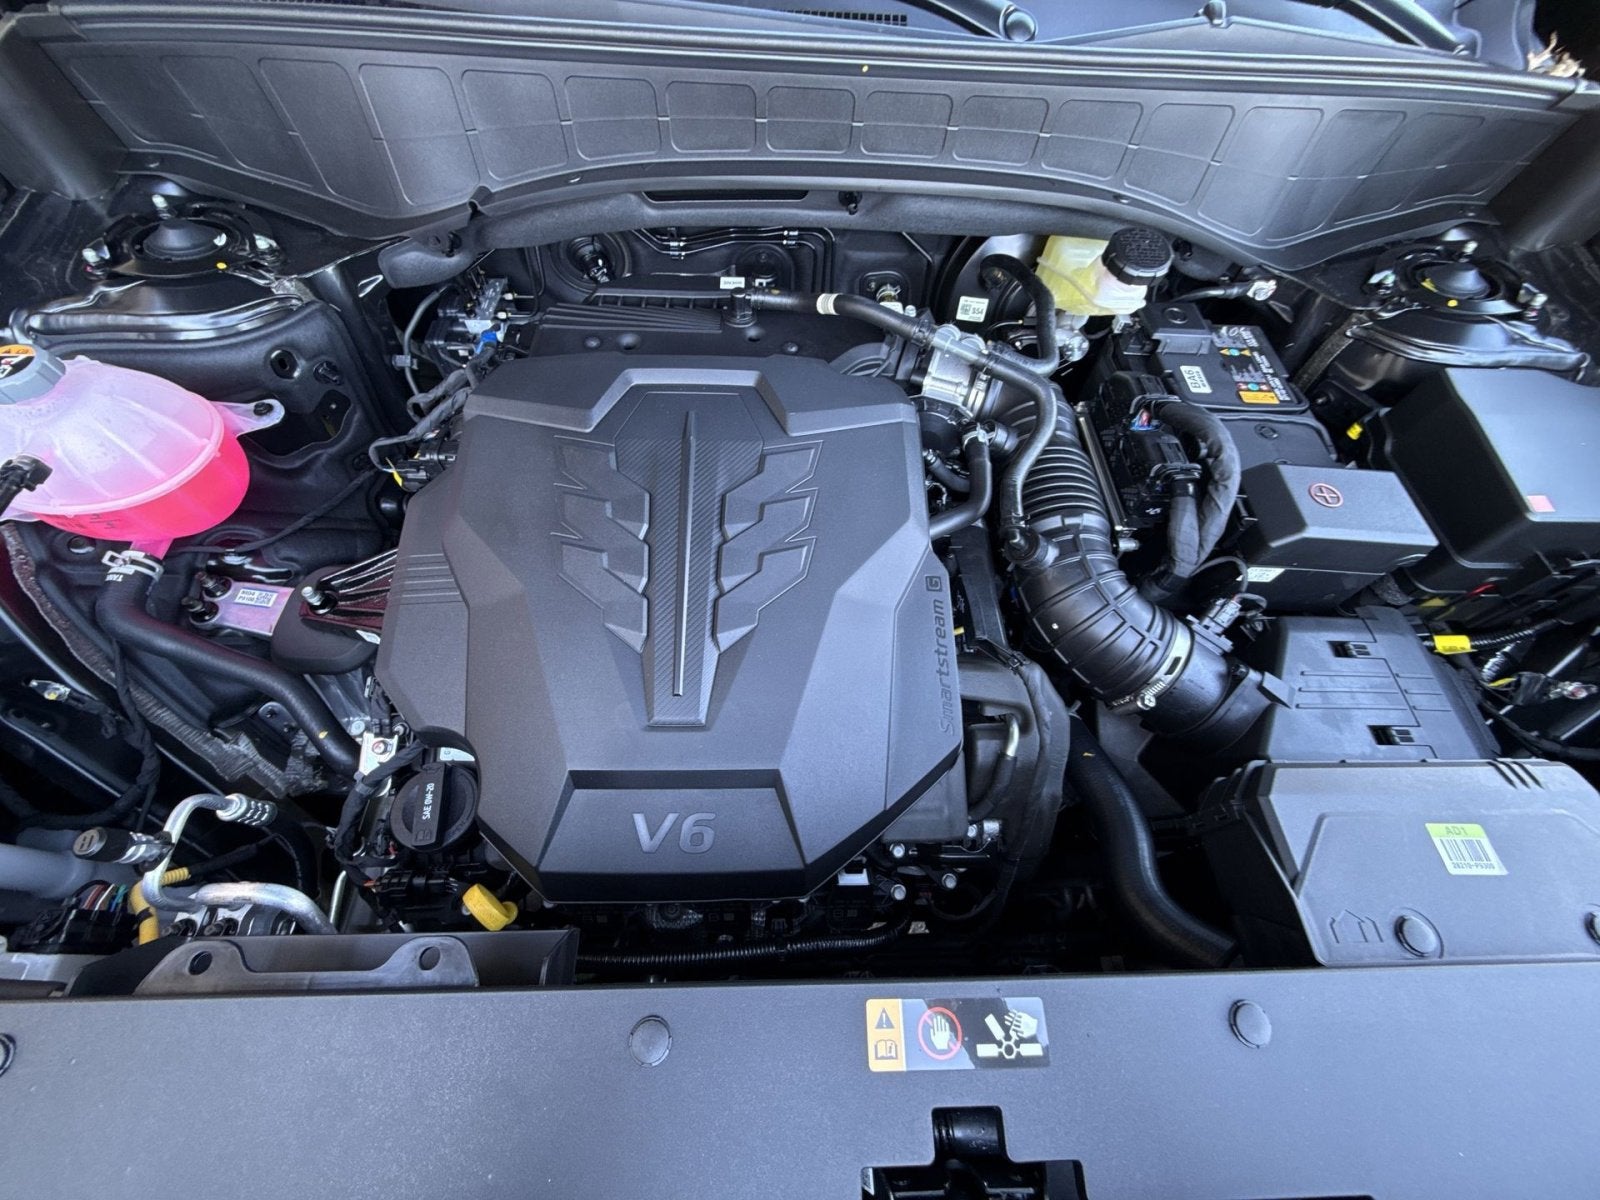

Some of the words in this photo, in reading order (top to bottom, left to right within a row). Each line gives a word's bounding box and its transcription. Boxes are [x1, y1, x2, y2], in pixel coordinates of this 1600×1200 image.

[1183, 369, 1201, 389] BA6
[932, 599, 955, 736] Smartstream
[424, 782, 435, 805] 0W-20
[421, 805, 433, 820] SAE
[632, 812, 717, 855] V6
[1444, 826, 1469, 836] AD1
